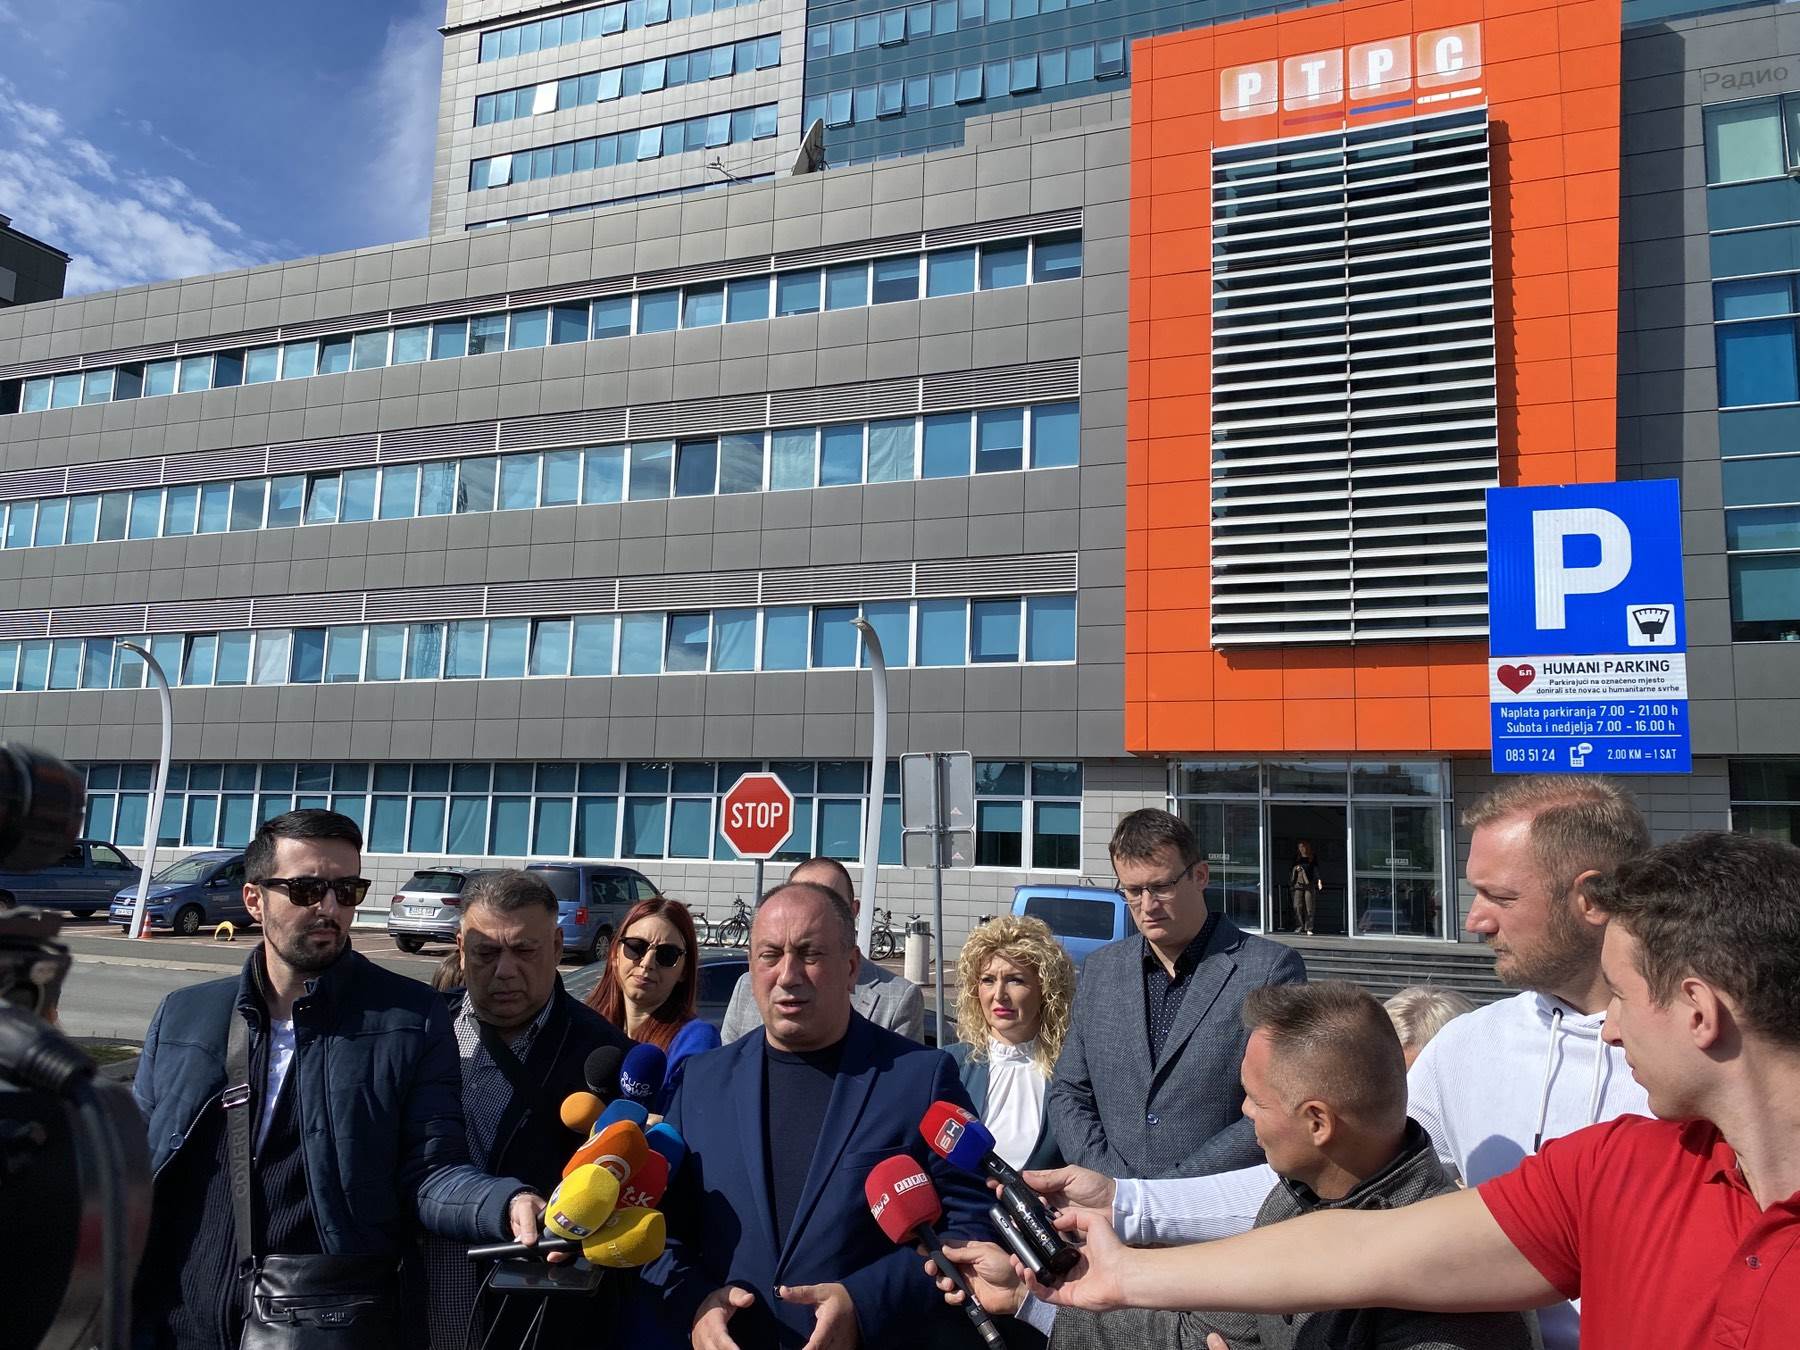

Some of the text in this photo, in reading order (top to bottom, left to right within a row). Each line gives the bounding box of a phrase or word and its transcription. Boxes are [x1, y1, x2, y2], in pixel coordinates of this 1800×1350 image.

[1238, 36, 1463, 112] РТРС
[1703, 66, 1788, 92] Радио
[1532, 507, 1632, 630] P
[1543, 660, 1670, 675] HUMANI PARKING
[1638, 676, 1665, 685] mjesto
[1536, 687, 1563, 695] donirali
[1608, 684, 1656, 693] humanitarne
[1657, 684, 1680, 692] svrhe
[1500, 707, 1540, 720] Naplata
[1543, 706, 1597, 720] parkiranja
[1599, 705, 1625, 717] 7.00
[1638, 704, 1668, 716] 21.00
[1671, 705, 1679, 716] h
[1506, 721, 1542, 733] Subota
[1545, 721, 1549, 732] i
[1552, 720, 1593, 735] nedjelja
[1596, 720, 1622, 732] 7.00
[1635, 720, 1665, 732] 16.00
[1668, 720, 1675, 731] h
[1505, 748, 1525, 762] 083
[1528, 748, 1539, 761] 51
[1541, 748, 1555, 761] 24
[1628, 748, 1641, 760] KM
[1660, 748, 1677, 760] SAT
[731, 802, 783, 828] STOP
[623, 1071, 650, 1090] euro
